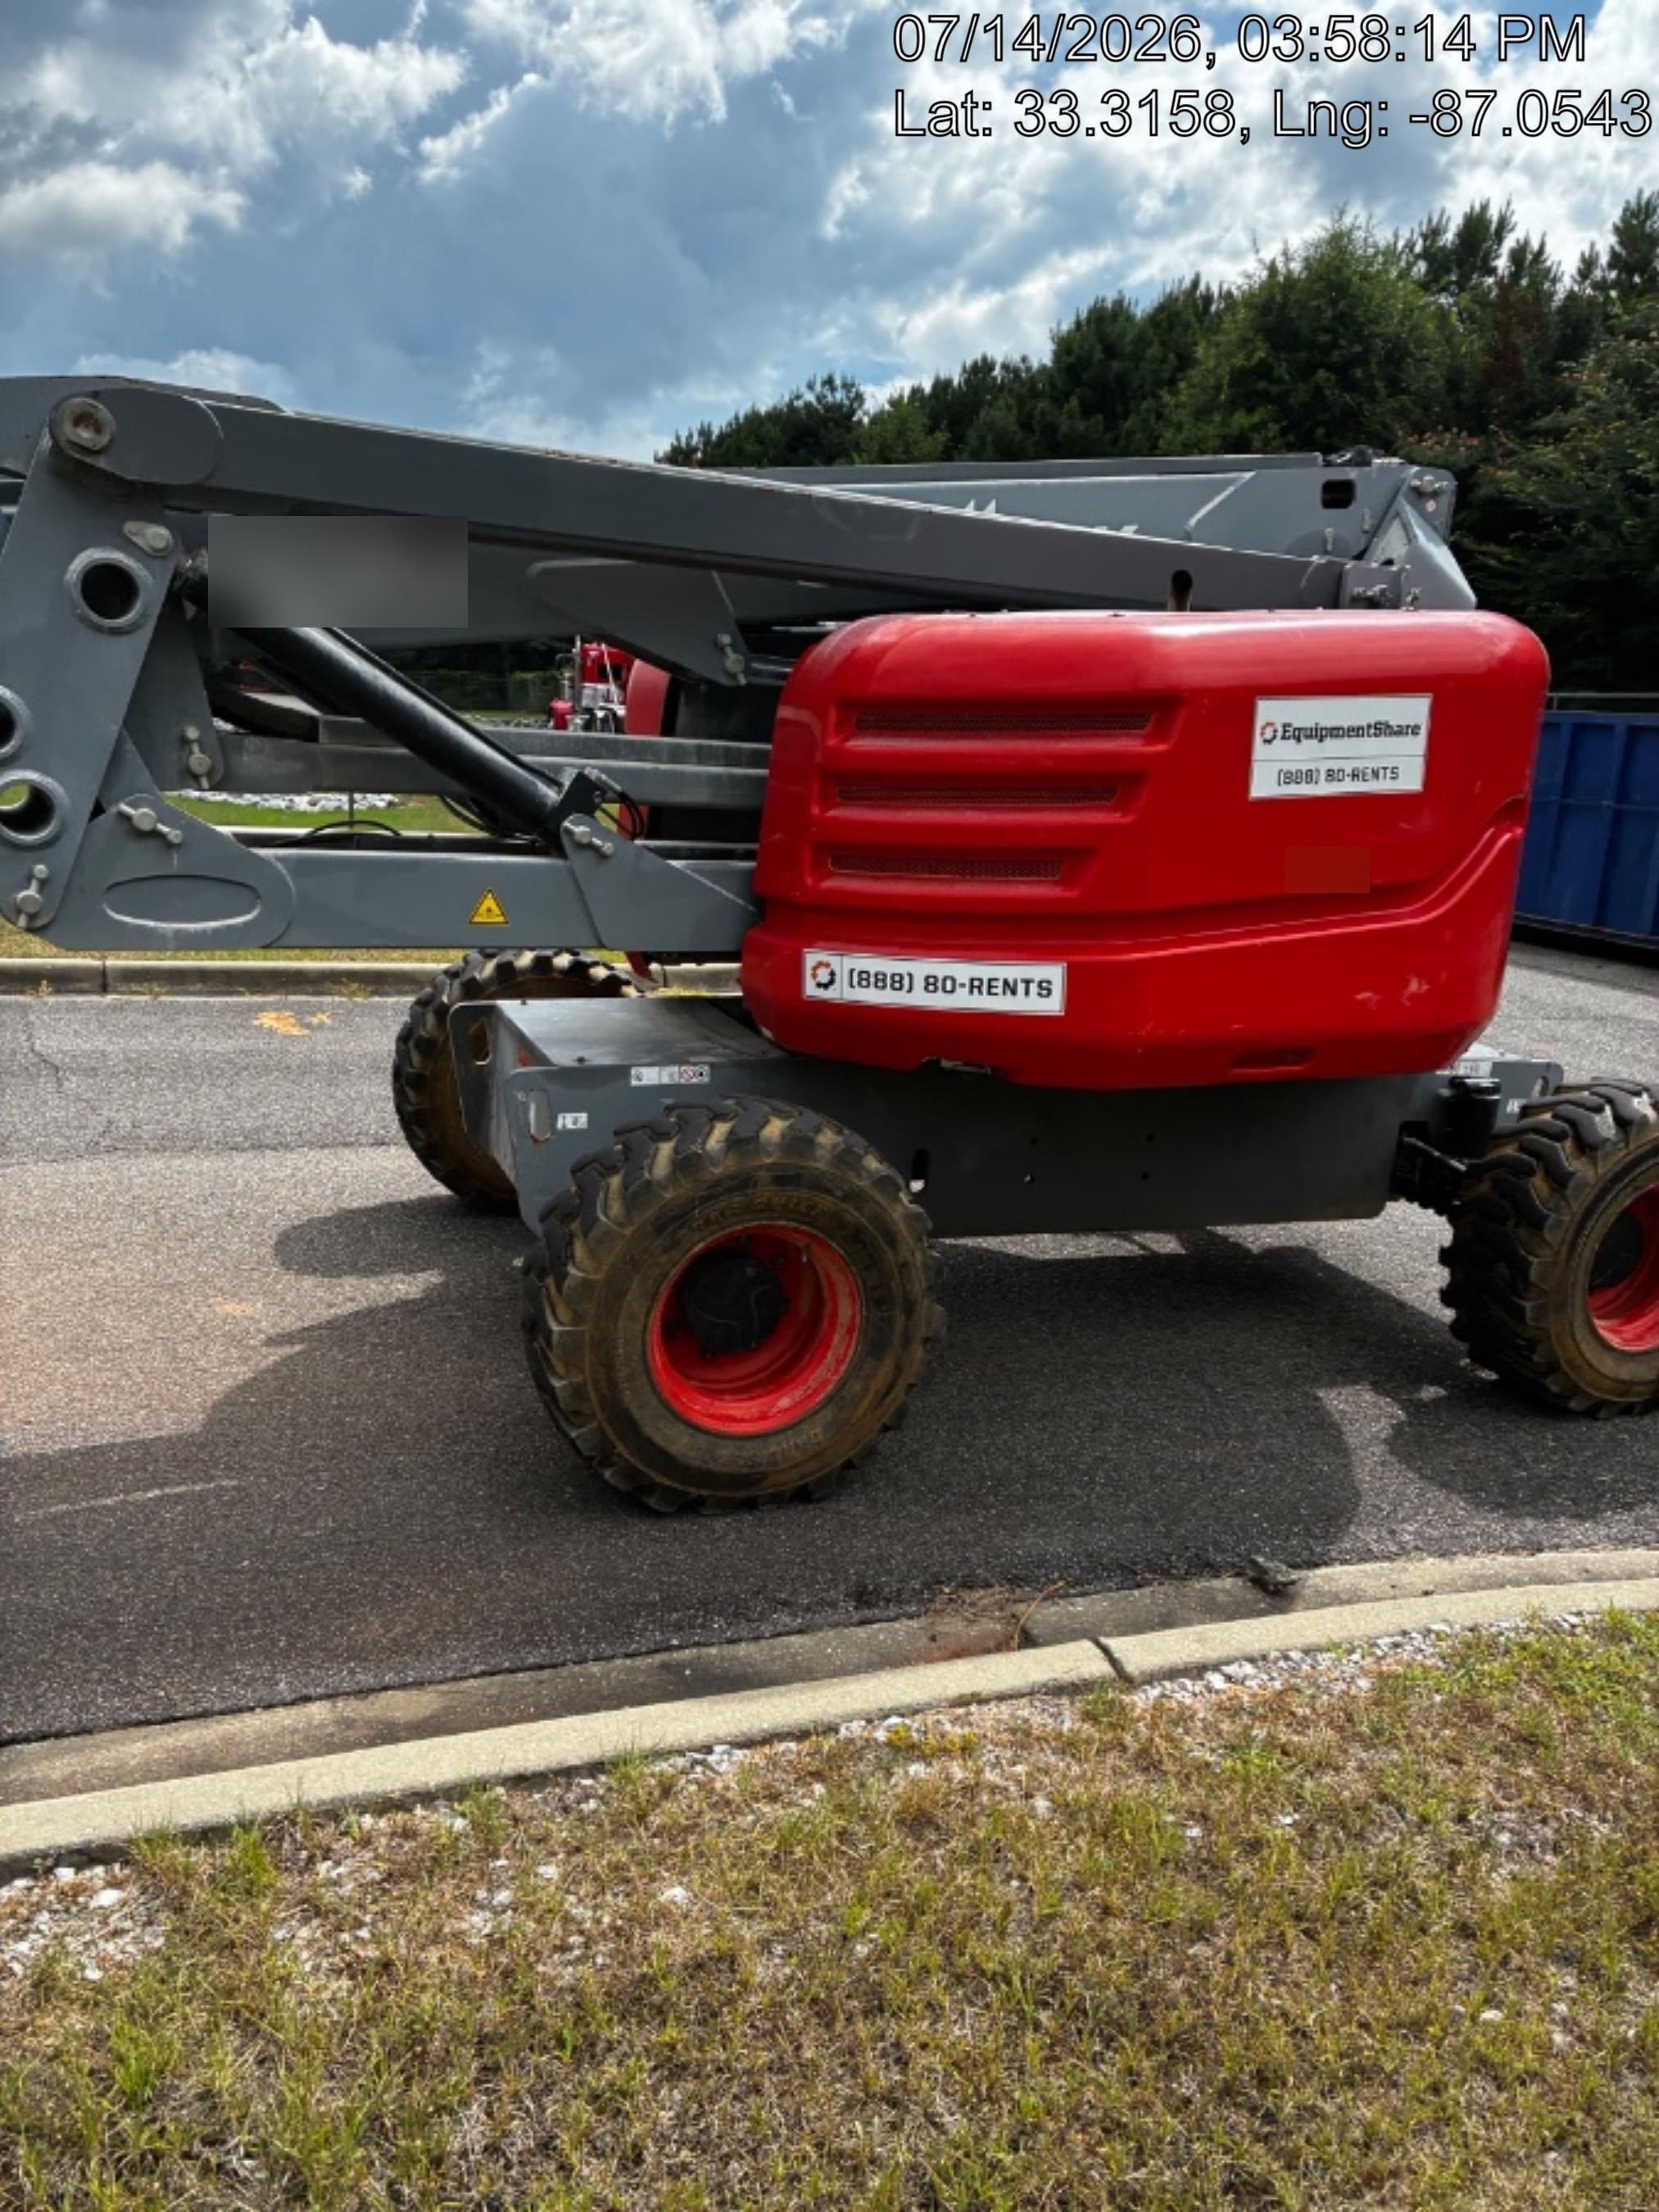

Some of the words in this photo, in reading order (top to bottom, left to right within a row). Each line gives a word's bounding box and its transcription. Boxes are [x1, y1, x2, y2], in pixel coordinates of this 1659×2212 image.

[1280, 720, 1422, 744] EquipmentShare
[1277, 767, 1321, 787] (888)
[1324, 765, 1400, 784] 80-RENTS
[848, 968, 914, 994] (888)
[922, 974, 1054, 999] 80-RENTS
